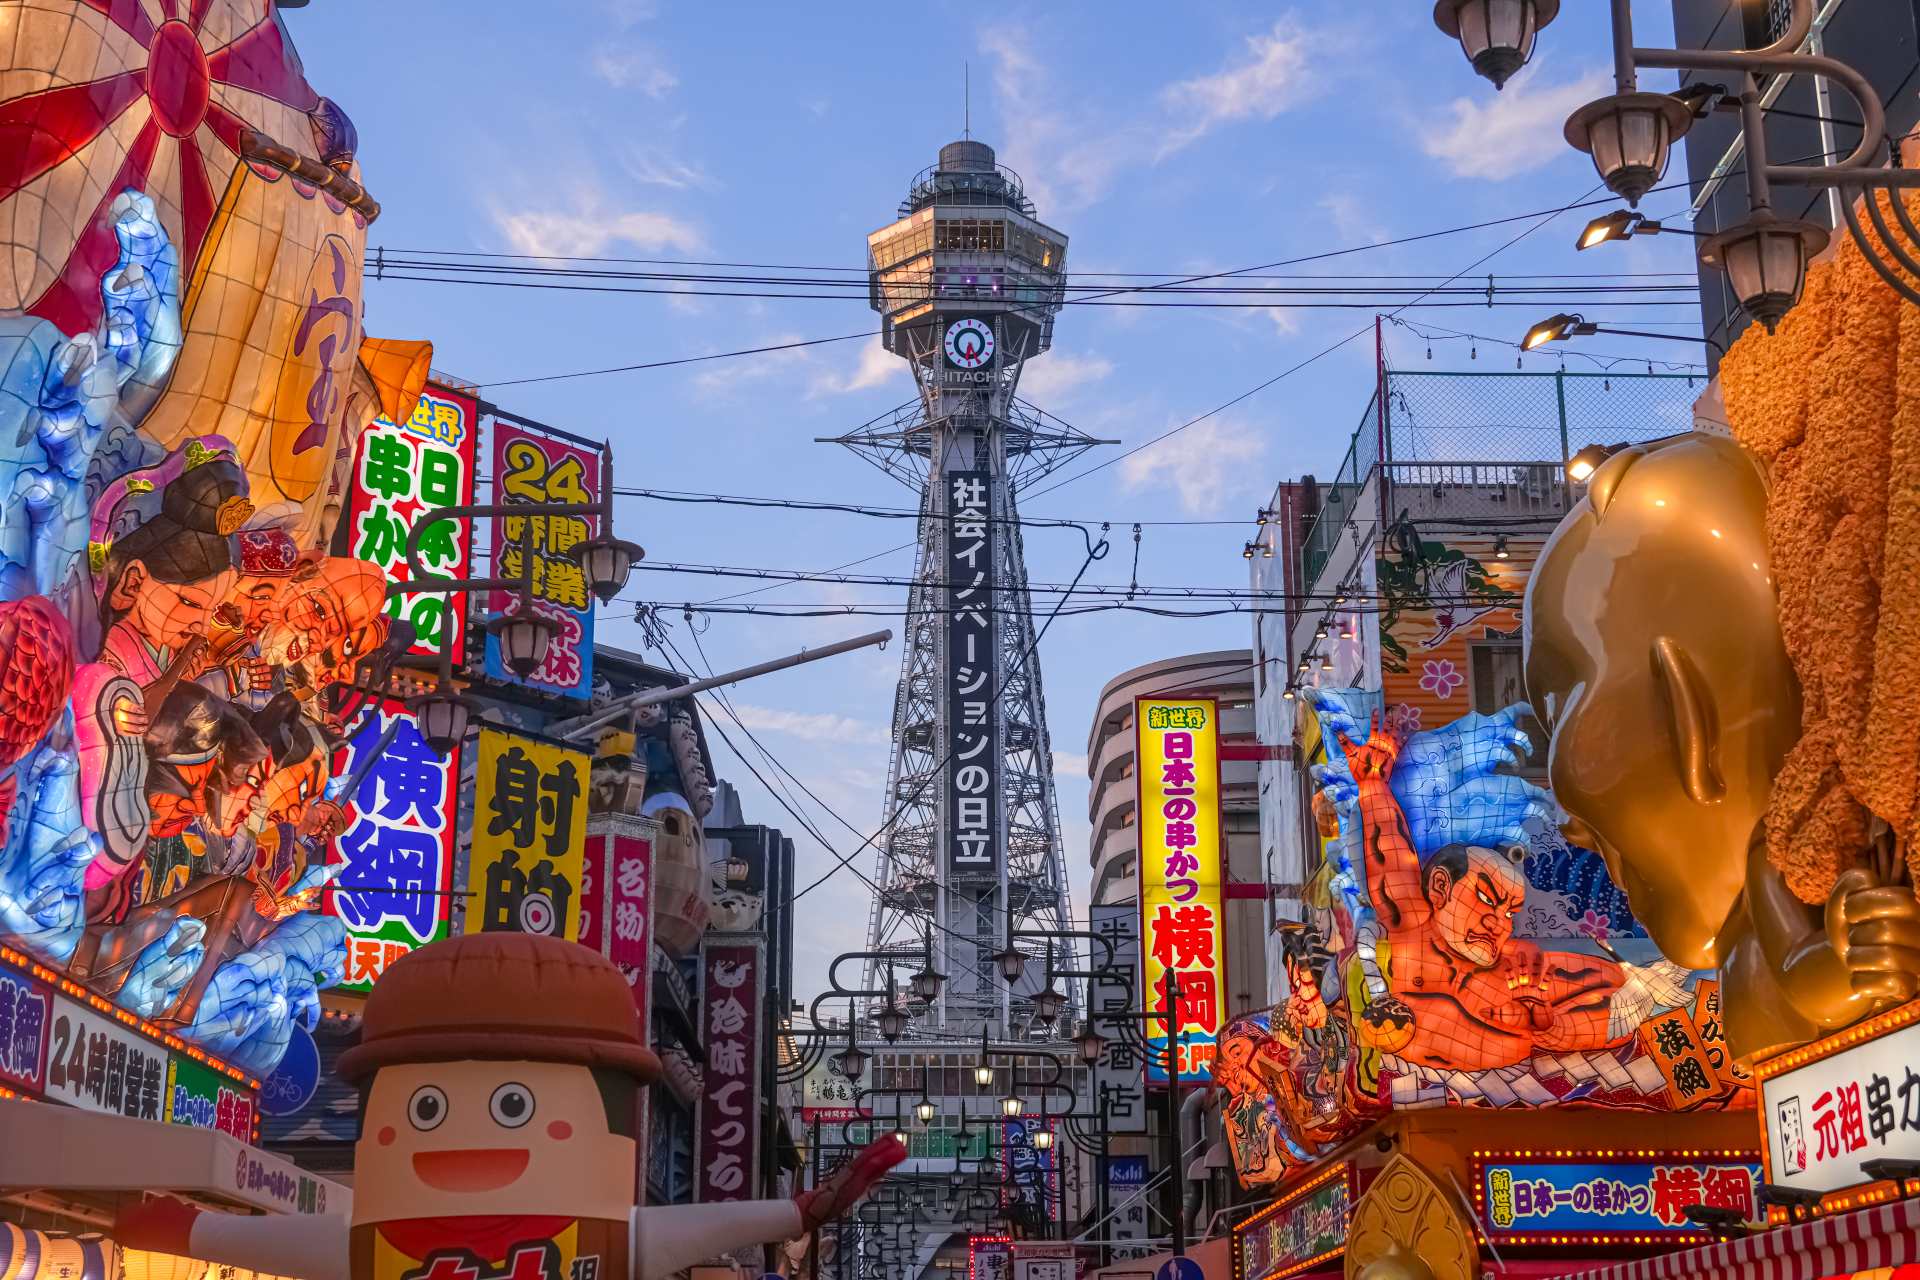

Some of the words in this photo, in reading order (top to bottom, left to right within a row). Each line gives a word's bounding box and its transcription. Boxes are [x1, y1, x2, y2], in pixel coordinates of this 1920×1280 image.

[374, 397, 462, 447] 世界
[503, 441, 590, 504] 24
[953, 478, 992, 864] 社会イノベーションの日立
[1149, 706, 1205, 729] 新世界
[482, 747, 580, 937] 射的
[1162, 732, 1199, 902] 日本一の串かつ
[617, 857, 645, 942] 名物
[1151, 905, 1217, 1034] 横綱
[50, 1014, 162, 1121] 24時間営業
[1514, 1181, 1650, 1215] 日本一の串かつ
[1652, 1168, 1752, 1224] 横綱
